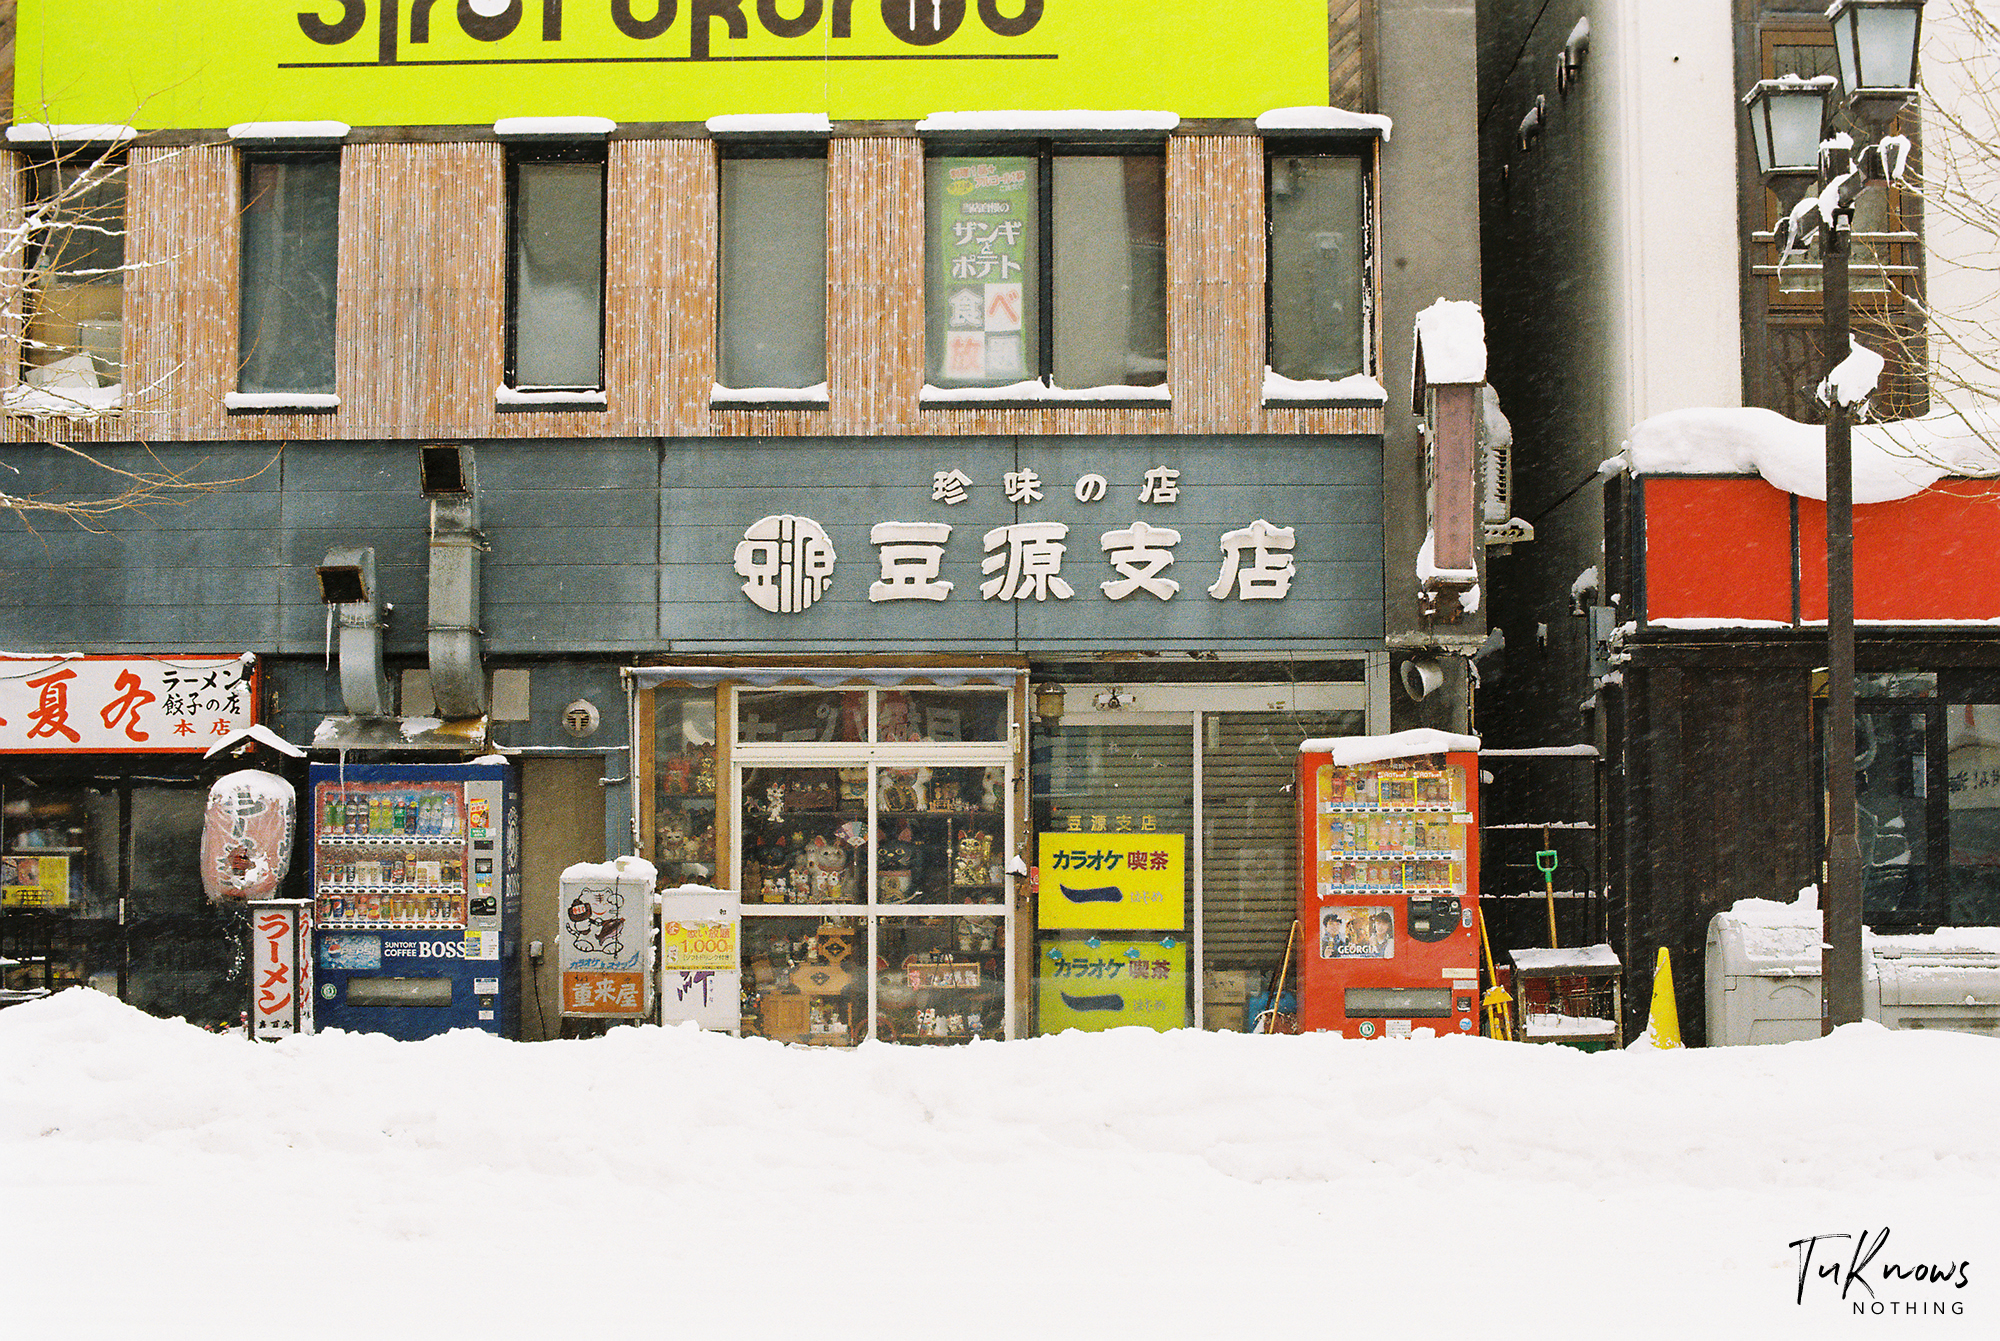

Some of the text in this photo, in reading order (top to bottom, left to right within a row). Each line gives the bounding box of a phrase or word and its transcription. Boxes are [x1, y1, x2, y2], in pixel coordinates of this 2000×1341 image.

[953, 221, 1022, 245] ザンギ
[981, 242, 994, 254] と
[953, 254, 1021, 279] ポテト
[932, 465, 1181, 504] 珍味の店
[868, 518, 1296, 601] 豆源支店
[162, 670, 243, 692] ラーメン
[0, 668, 156, 744] 夏冬
[162, 693, 241, 716] 餃子の店
[173, 718, 231, 737] 本店
[1066, 815, 1157, 831] 豆源支店
[384, 949, 417, 957] COFFEE
[418, 941, 466, 958] BOSS
[680, 939, 734, 953] 1,000円
[1337, 945, 1379, 954] GEORGIA
[257, 913, 291, 1016] ラーメン
[572, 977, 639, 1007] 重来屋
